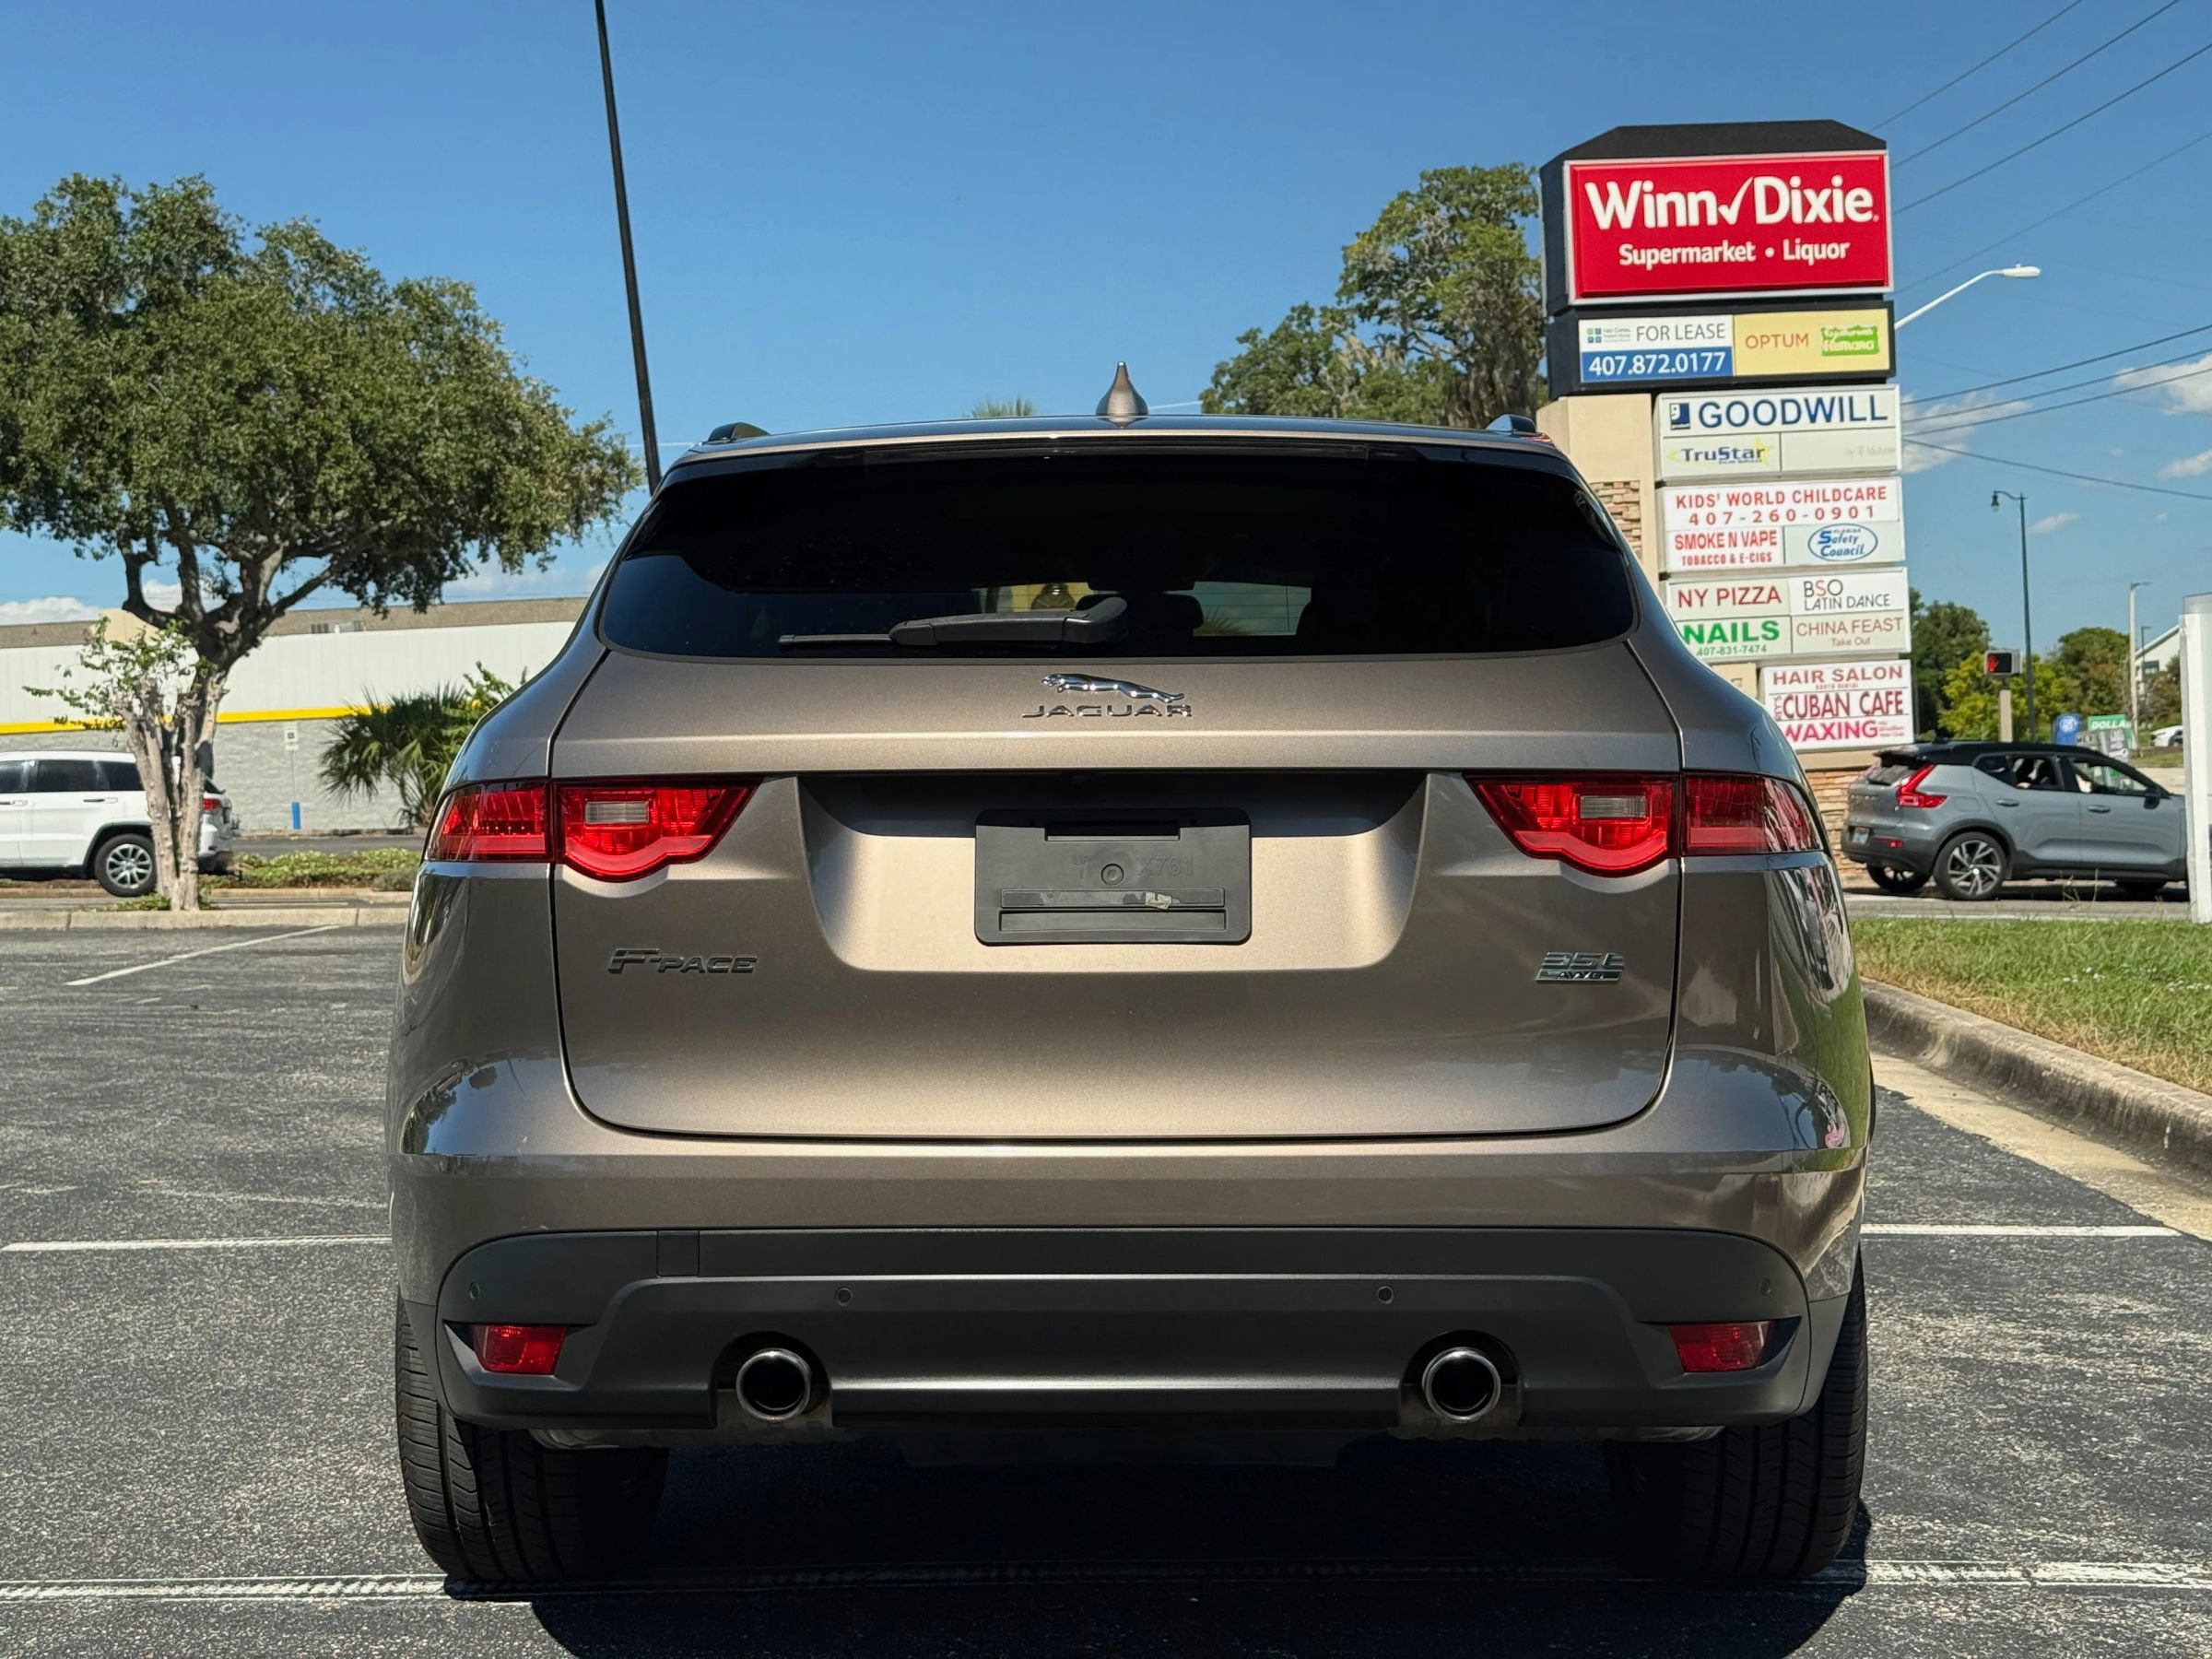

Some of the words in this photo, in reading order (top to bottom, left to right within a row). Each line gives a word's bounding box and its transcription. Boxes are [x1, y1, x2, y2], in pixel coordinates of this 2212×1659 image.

[1584, 179, 1718, 229] Winn
[1754, 175, 1874, 224] Dixie
[1618, 240, 1756, 270] Supermarket
[1783, 237, 1851, 265] Liquor
[1636, 325, 1670, 342] FOR
[1675, 323, 1725, 340] LEASE
[1745, 333, 1809, 349] OPTUM
[1588, 351, 1726, 376] 407.872.0177
[1699, 394, 1888, 428] GOODWILL
[1680, 446, 1766, 462] TruStar
[1676, 493, 1721, 509] KIDS'
[1726, 490, 1785, 507] WORLD
[1792, 486, 1888, 503] CHILDCARE
[1688, 505, 1875, 526] 407-260-0901
[1675, 532, 1726, 550] SMOKE
[1727, 531, 1738, 547] N
[1740, 530, 1778, 547] VAPE
[1818, 530, 1858, 545] Safety
[1681, 554, 1727, 565] TOBACCO
[1730, 554, 1736, 563] &
[1739, 552, 1772, 563] E-CIGS
[1820, 544, 1865, 557] Council
[1677, 589, 1708, 608] NY
[1716, 586, 1783, 606] PIZZA
[1804, 579, 1843, 598] BSO
[1805, 596, 1842, 611] LATIN
[1846, 594, 1890, 609] DANCE
[1683, 619, 1780, 644] NAILS
[1796, 620, 1848, 637] CHINA
[1851, 617, 1904, 635] FEAST
[1697, 644, 1767, 656] 407-831-7474
[1831, 638, 1853, 646] Take
[1854, 636, 1871, 645] Out
[1773, 670, 1825, 685] HAIR
[1831, 665, 1903, 682] SALON
[1021, 704, 1193, 718] JAGUAR
[1783, 692, 1851, 719] CUBAN
[1859, 690, 1904, 716] CAFE
[1784, 721, 1878, 742] WAXING
[608, 947, 758, 974] F-PACE
